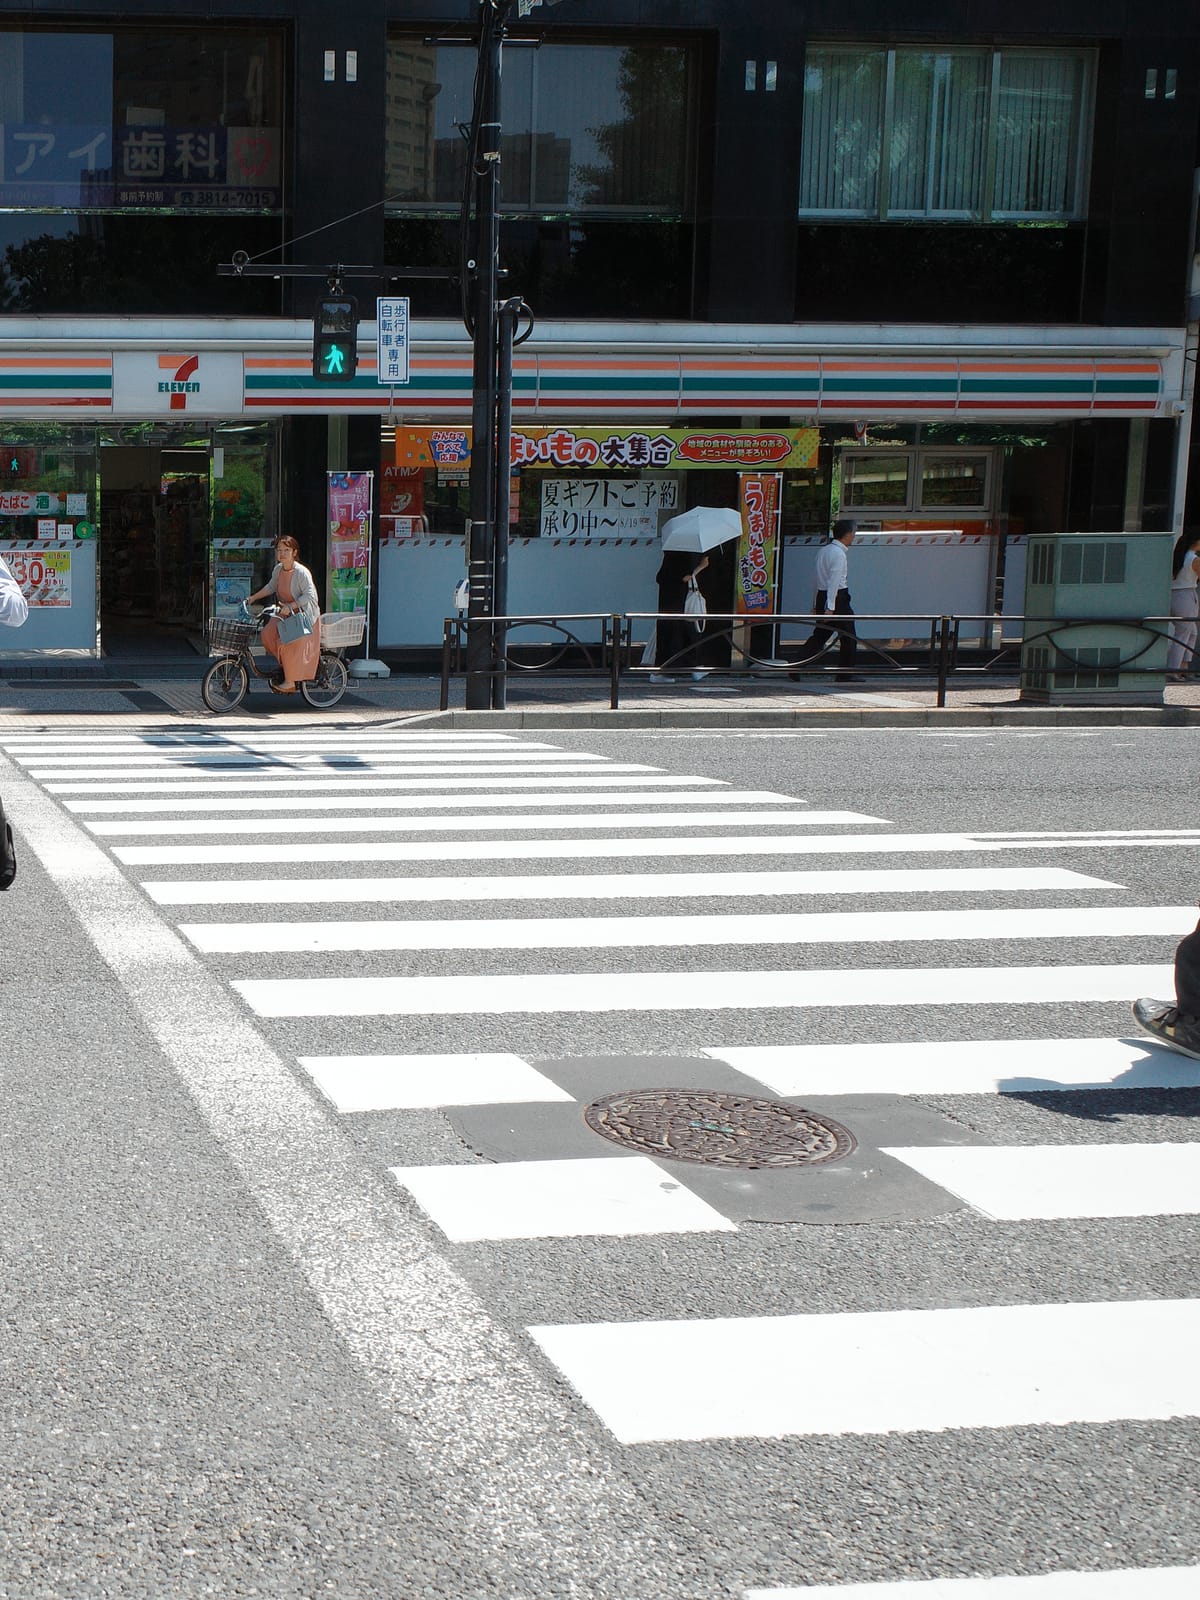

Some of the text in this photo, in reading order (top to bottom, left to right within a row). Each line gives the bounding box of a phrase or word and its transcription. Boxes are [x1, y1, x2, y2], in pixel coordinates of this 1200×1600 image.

[13, 131, 220, 178] アイ歯科
[381, 304, 392, 347] 自転車
[394, 304, 405, 347] 歩行者
[388, 349, 399, 376] 専用
[432, 431, 465, 441] みんなで
[436, 442, 461, 452] 食べて
[510, 431, 676, 465] まいもの大集合
[384, 467, 410, 477] ATM
[0, 495, 49, 509] たばこ 酒
[543, 480, 677, 508] 夏ギフトご予約
[745, 483, 767, 586] うまいもの
[740, 557, 752, 592] 大集合
